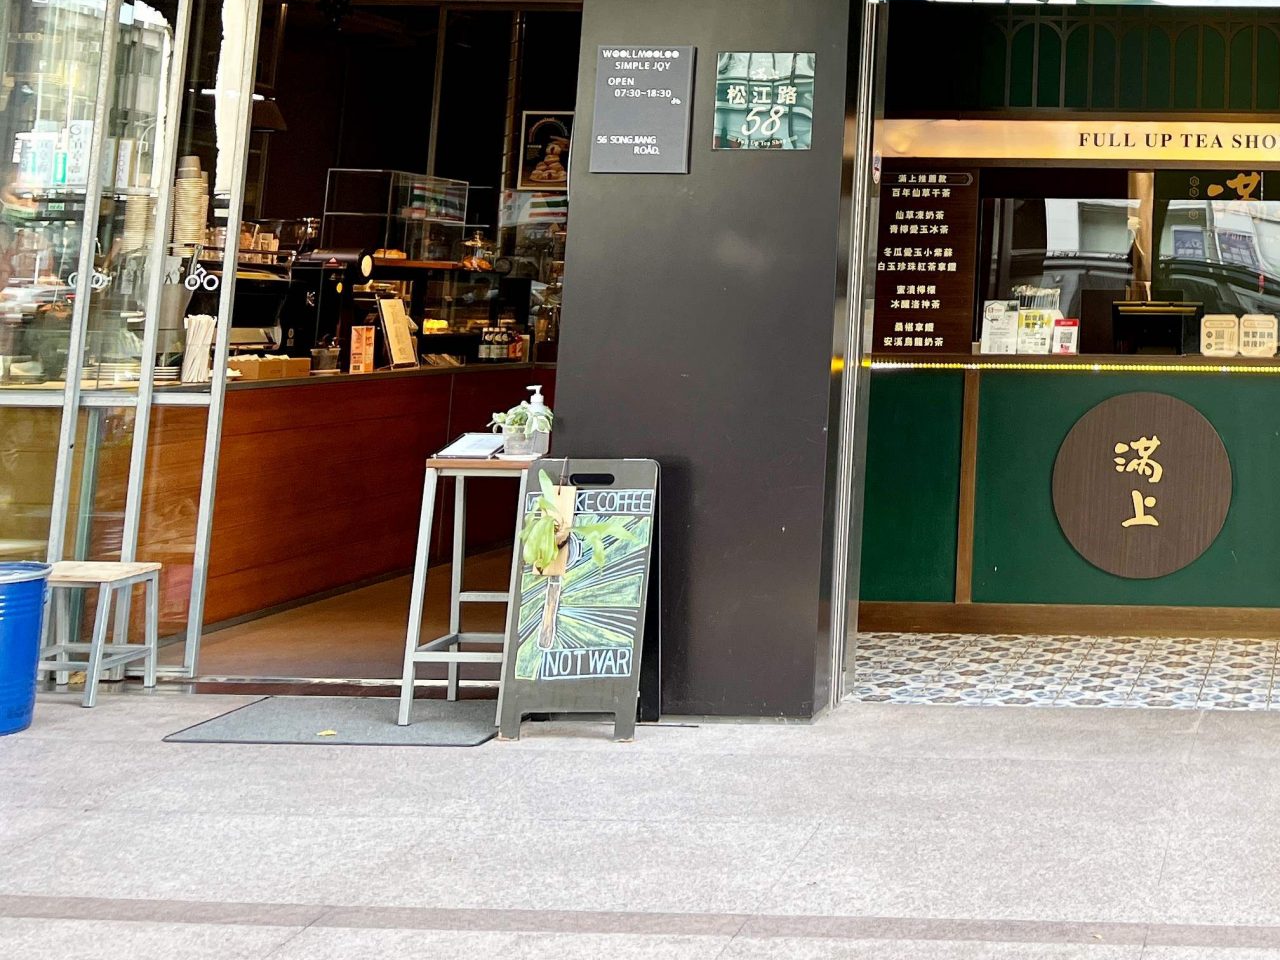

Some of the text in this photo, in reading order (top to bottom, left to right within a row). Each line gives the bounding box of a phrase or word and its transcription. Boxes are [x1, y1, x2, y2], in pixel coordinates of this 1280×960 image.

[615, 61, 671, 71] SIMPLE JOY
[608, 77, 635, 86] OPEN
[726, 85, 798, 105] 松江路
[741, 105, 785, 136] 58
[1078, 132, 1136, 148] FULL
[1145, 133, 1172, 148] UP
[1180, 134, 1224, 149] TEA
[1113, 435, 1163, 528] 滿上
[596, 491, 652, 512] COFFEE
[545, 648, 631, 677] NOT WAR
